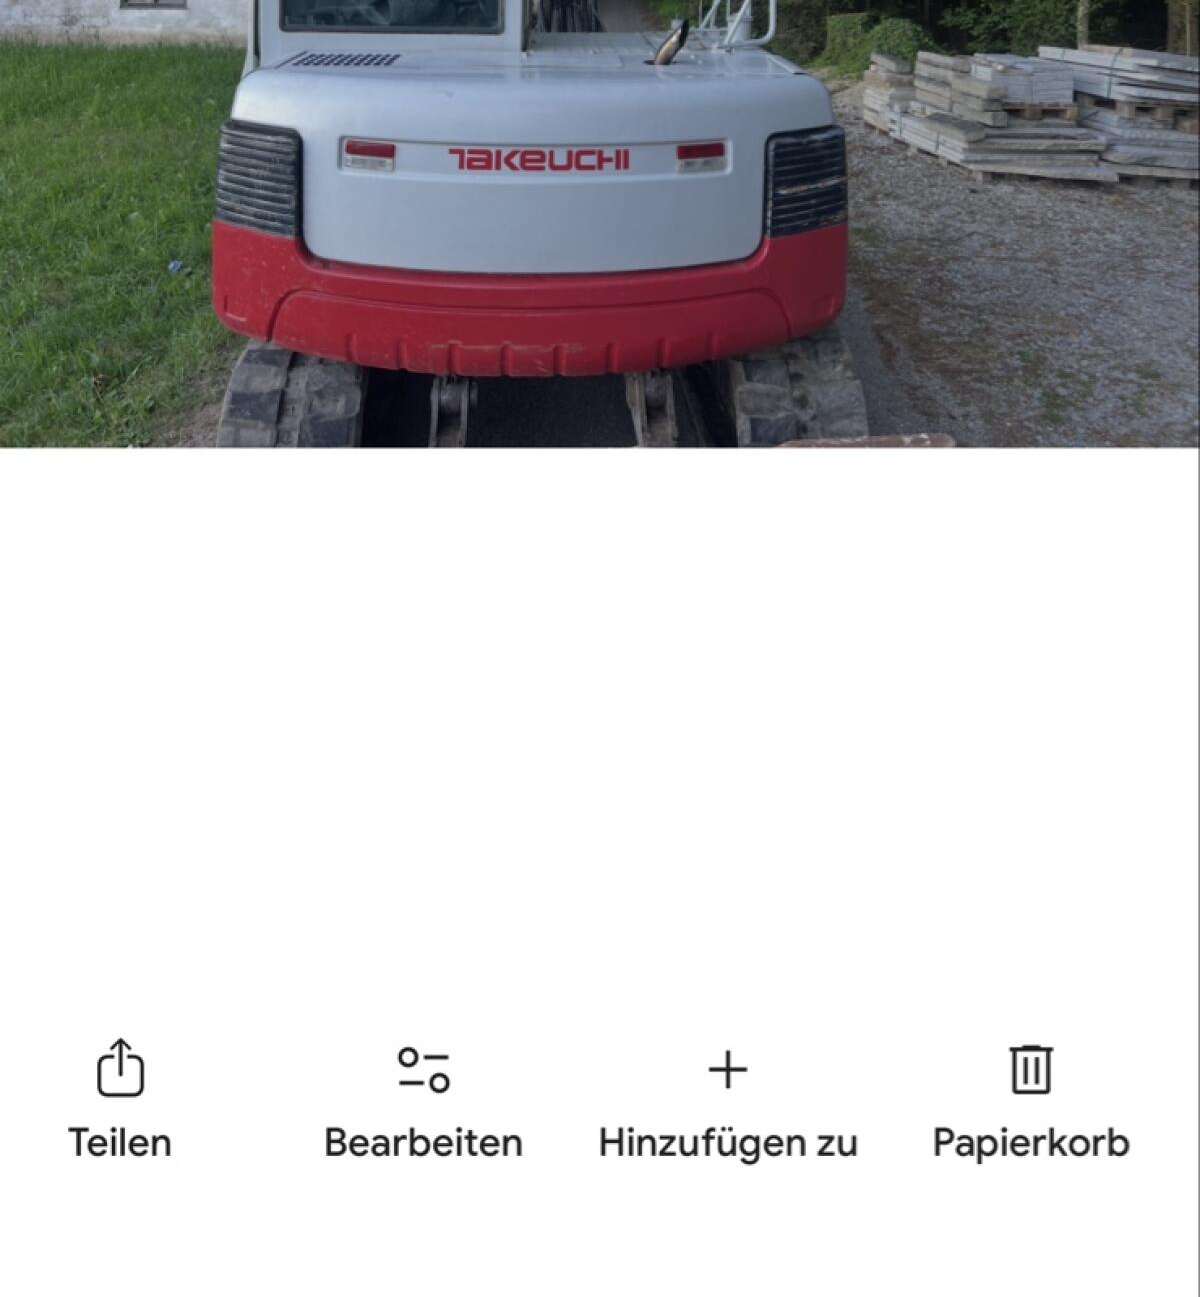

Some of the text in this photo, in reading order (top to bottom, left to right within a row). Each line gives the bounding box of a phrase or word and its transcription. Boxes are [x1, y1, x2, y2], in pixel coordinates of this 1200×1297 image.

[448, 148, 630, 171] TAKEUCHI
[68, 1126, 172, 1157] Teilen
[325, 1126, 523, 1157] Bearbeiten
[599, 1126, 858, 1166] Hinzufügen zu
[934, 1126, 1130, 1165] Papierkorb
